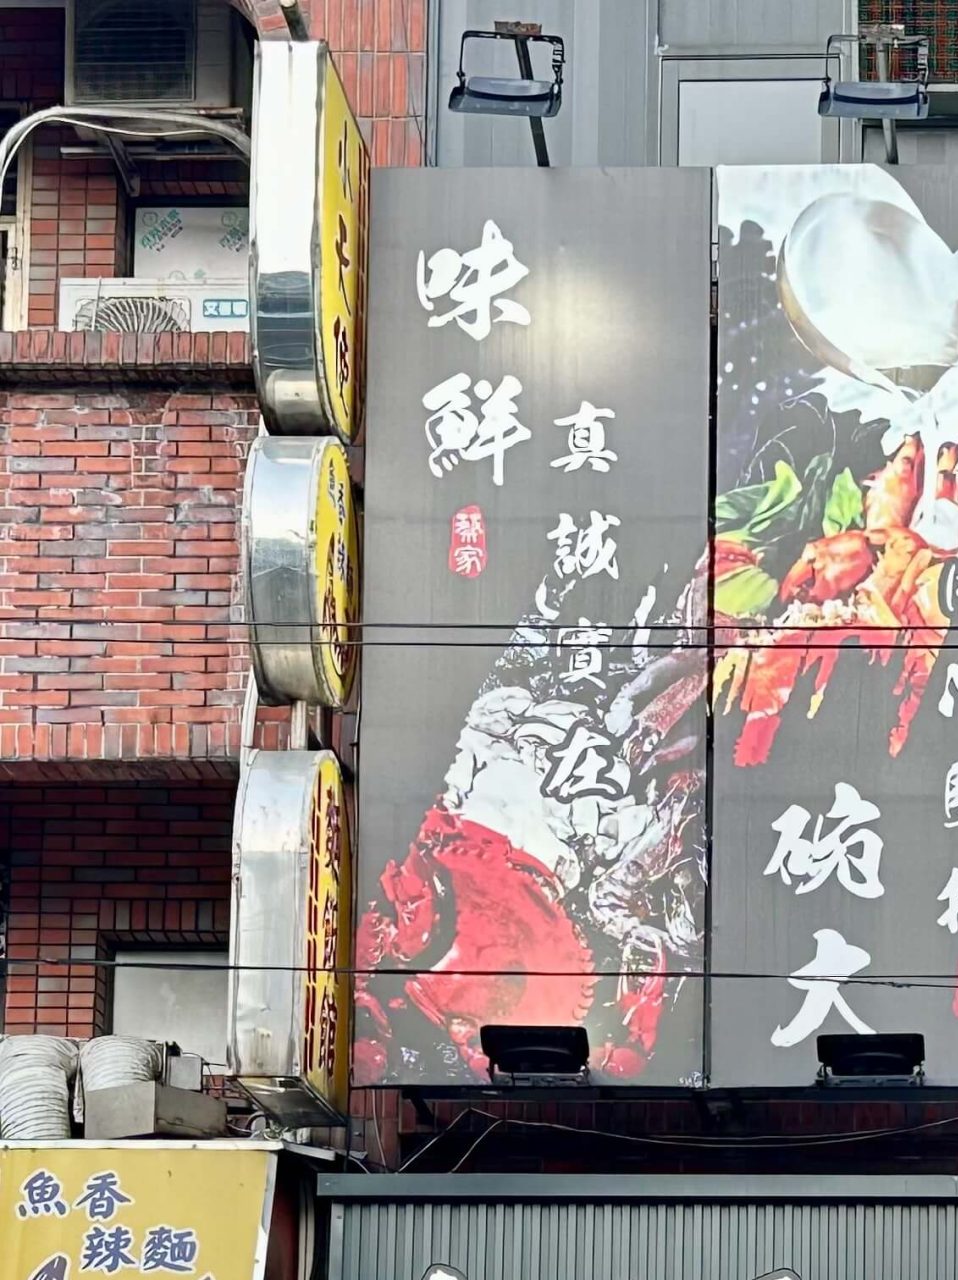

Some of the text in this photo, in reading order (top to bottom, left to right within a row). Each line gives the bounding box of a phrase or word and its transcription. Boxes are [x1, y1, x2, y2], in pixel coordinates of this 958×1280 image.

[416, 219, 532, 486] 味鮮
[547, 401, 621, 797] 真誠實在
[18, 1171, 132, 1219] 魚香
[81, 1226, 196, 1273] 辣麵
